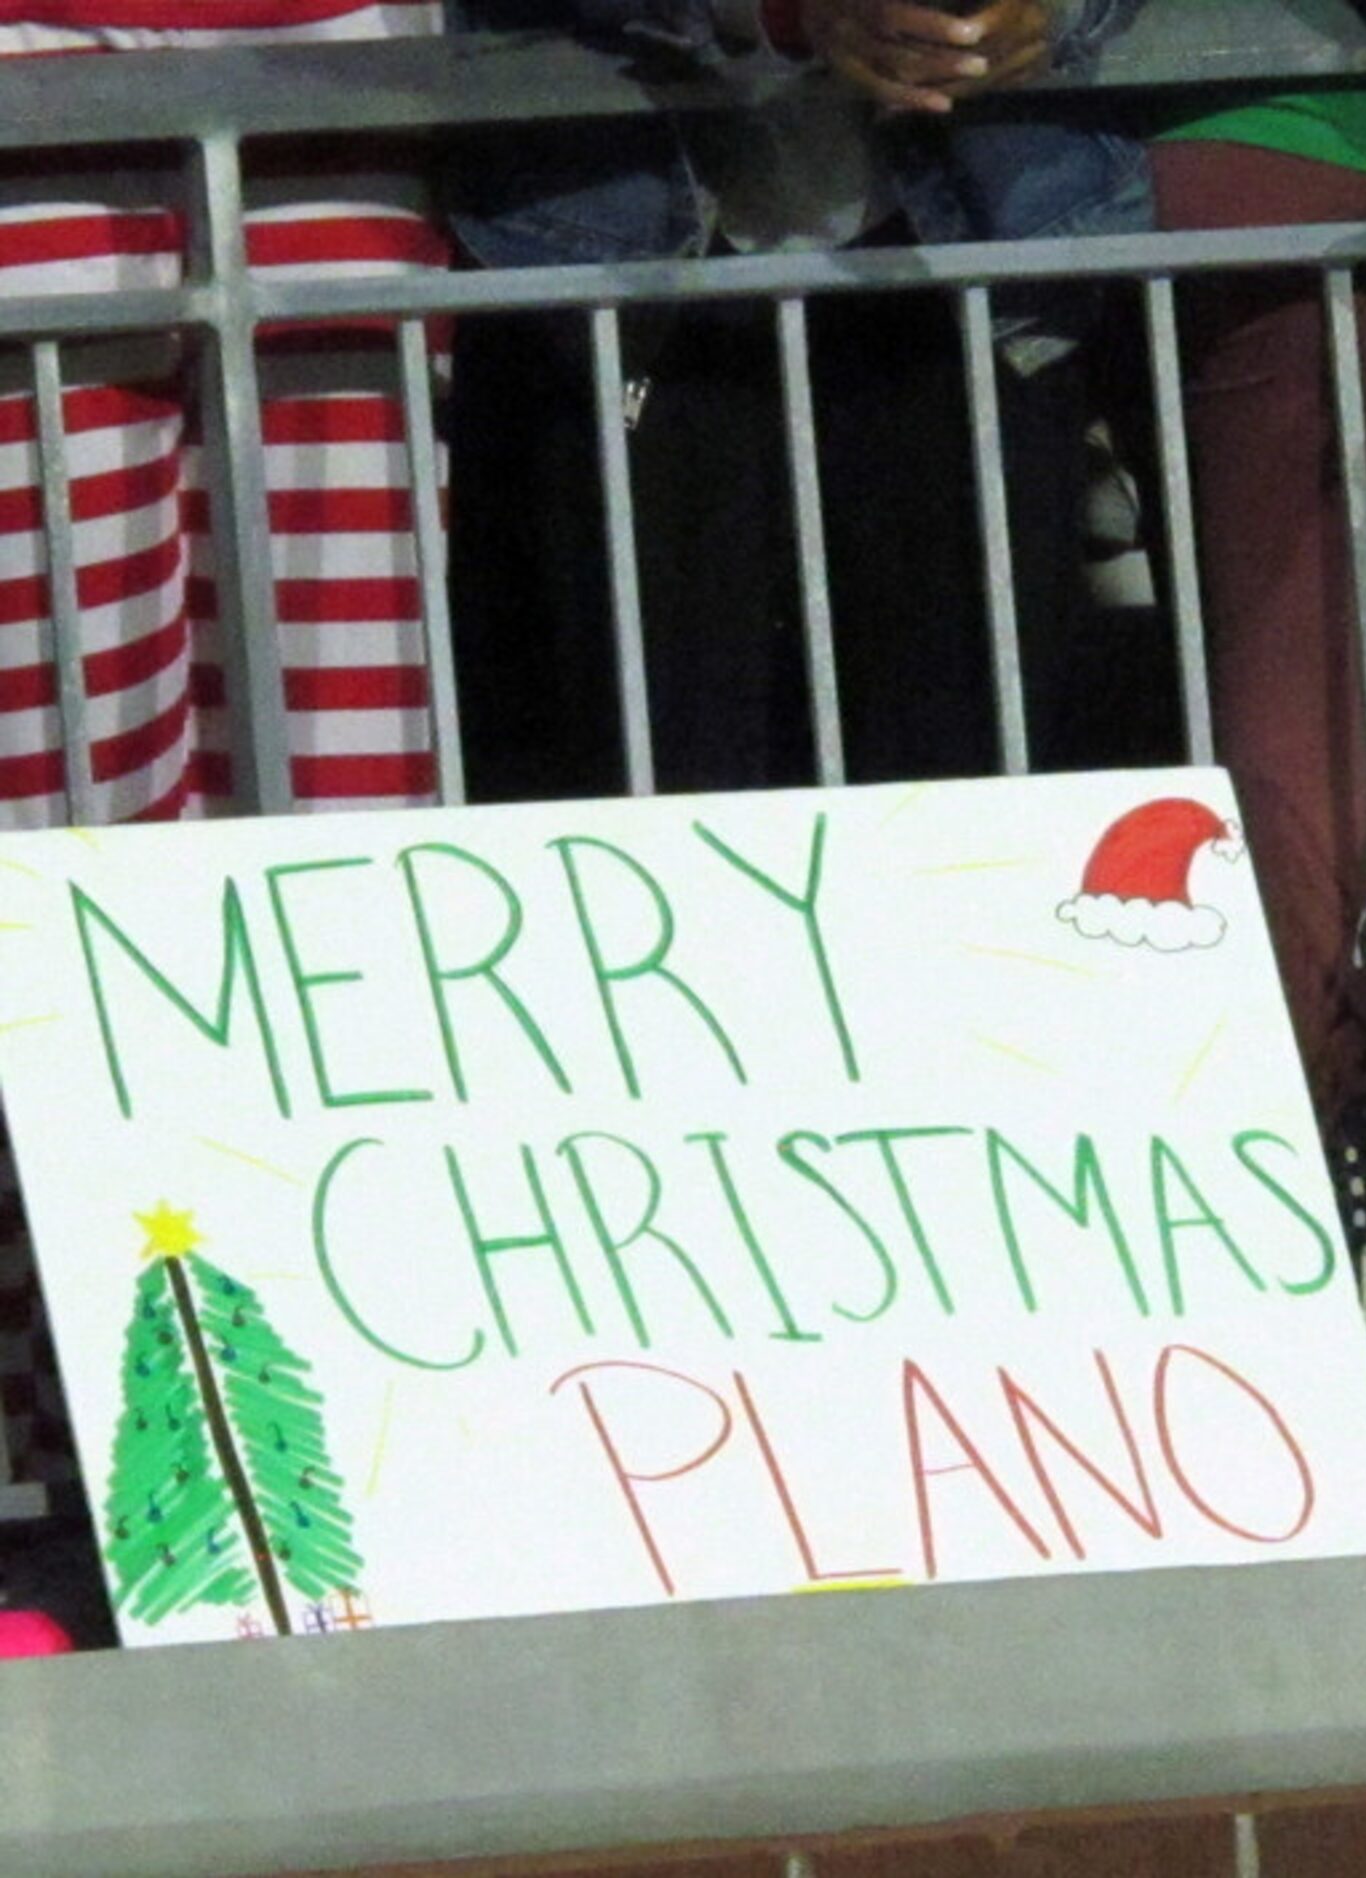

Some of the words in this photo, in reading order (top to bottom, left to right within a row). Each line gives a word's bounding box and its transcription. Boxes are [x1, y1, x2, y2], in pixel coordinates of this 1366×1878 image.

[69, 812, 859, 1120] MERRY
[312, 1125, 1336, 1370] CHRISTMAS
[549, 1342, 1315, 1598] PLANO
